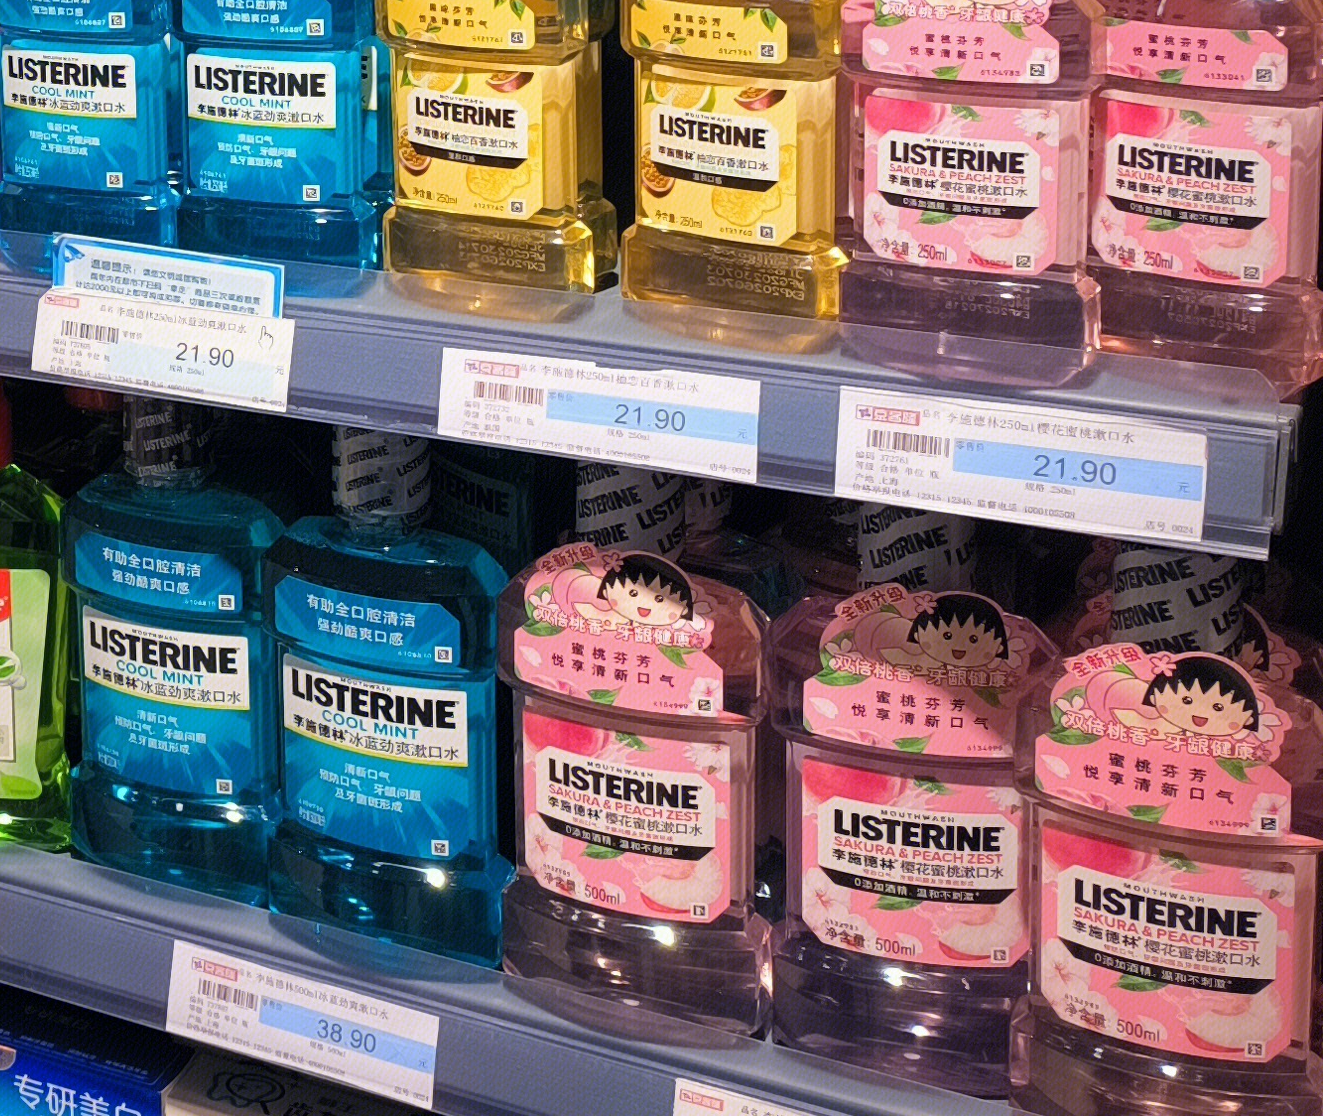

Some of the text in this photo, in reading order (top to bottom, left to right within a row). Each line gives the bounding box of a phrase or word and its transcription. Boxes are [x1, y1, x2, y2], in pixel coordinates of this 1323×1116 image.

[8, 56, 126, 89] LISTERINE
[193, 64, 326, 98] LISTERINE
[32, 85, 96, 100] COOL MINT
[221, 94, 292, 110] COOL MINT
[415, 96, 516, 130] LISTERINE
[658, 113, 767, 150] LISTERINE
[889, 140, 1025, 176] LISTERINE
[889, 163, 1027, 185] SAKURA & PEACH ZEST
[1117, 144, 1255, 185] LISTERINE
[1116, 168, 1257, 195] SAKURA & PEACH ZEST
[917, 244, 948, 263] 250ml
[1143, 250, 1174, 271] 250ml
[175, 342, 236, 369] 21.90
[614, 403, 687, 433] 21.90
[1033, 454, 1117, 486] 21.90
[101, 547, 203, 578] 有助全口腔清洁
[306, 594, 416, 628] 有助全口腔清洁
[89, 621, 238, 675] LISTERINE
[116, 660, 204, 686] COOL MINT
[291, 670, 456, 730] LISTERINE
[322, 709, 420, 741] COOL MINT
[548, 758, 700, 811] LISTERINE
[548, 784, 701, 822] SAKURA & PEACH ZEST
[833, 808, 1001, 852] LISTERINE
[584, 884, 621, 906] 500ml
[1074, 877, 1259, 939] LISTERINE
[1073, 907, 1260, 952] SAKURA & PEACH ZEST
[874, 935, 917, 958] 500ml
[316, 1017, 378, 1056] 38.90
[1116, 1018, 1161, 1043] 500ml
